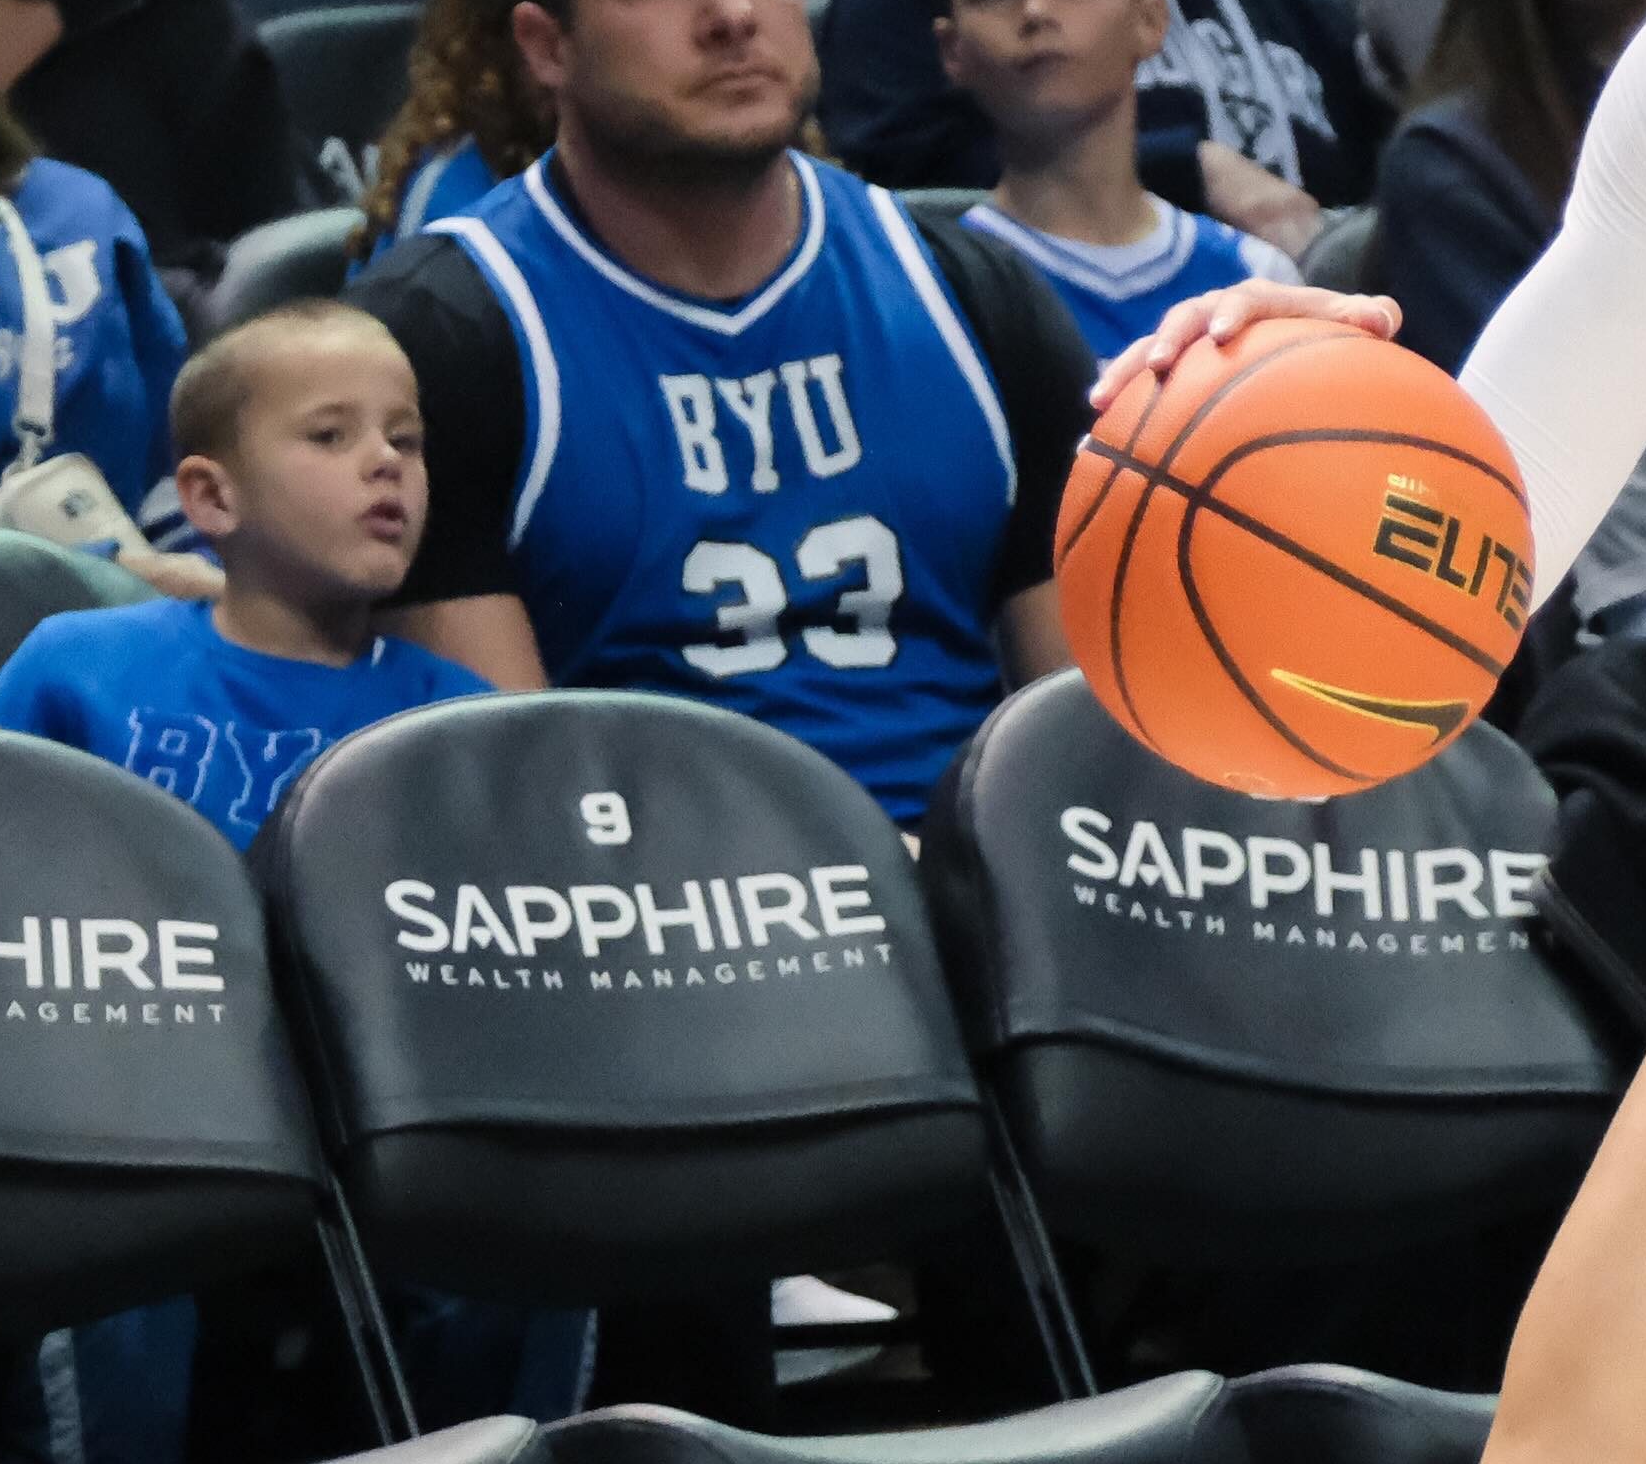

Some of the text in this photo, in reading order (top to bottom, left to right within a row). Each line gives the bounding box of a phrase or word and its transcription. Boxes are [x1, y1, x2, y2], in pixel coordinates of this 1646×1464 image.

[658, 353, 863, 495] BYU
[681, 513, 905, 678] 33
[1372, 490, 1536, 631] ELITE
[126, 705, 334, 829] BY
[579, 792, 632, 845] 9
[384, 864, 886, 957] SAPPHIRE
[1059, 805, 1549, 923] SAPPHIRE
[1074, 885, 1530, 955] WEALTH MANAGEMEN
[406, 943, 890, 990] WEALTH MANAGEMENT
